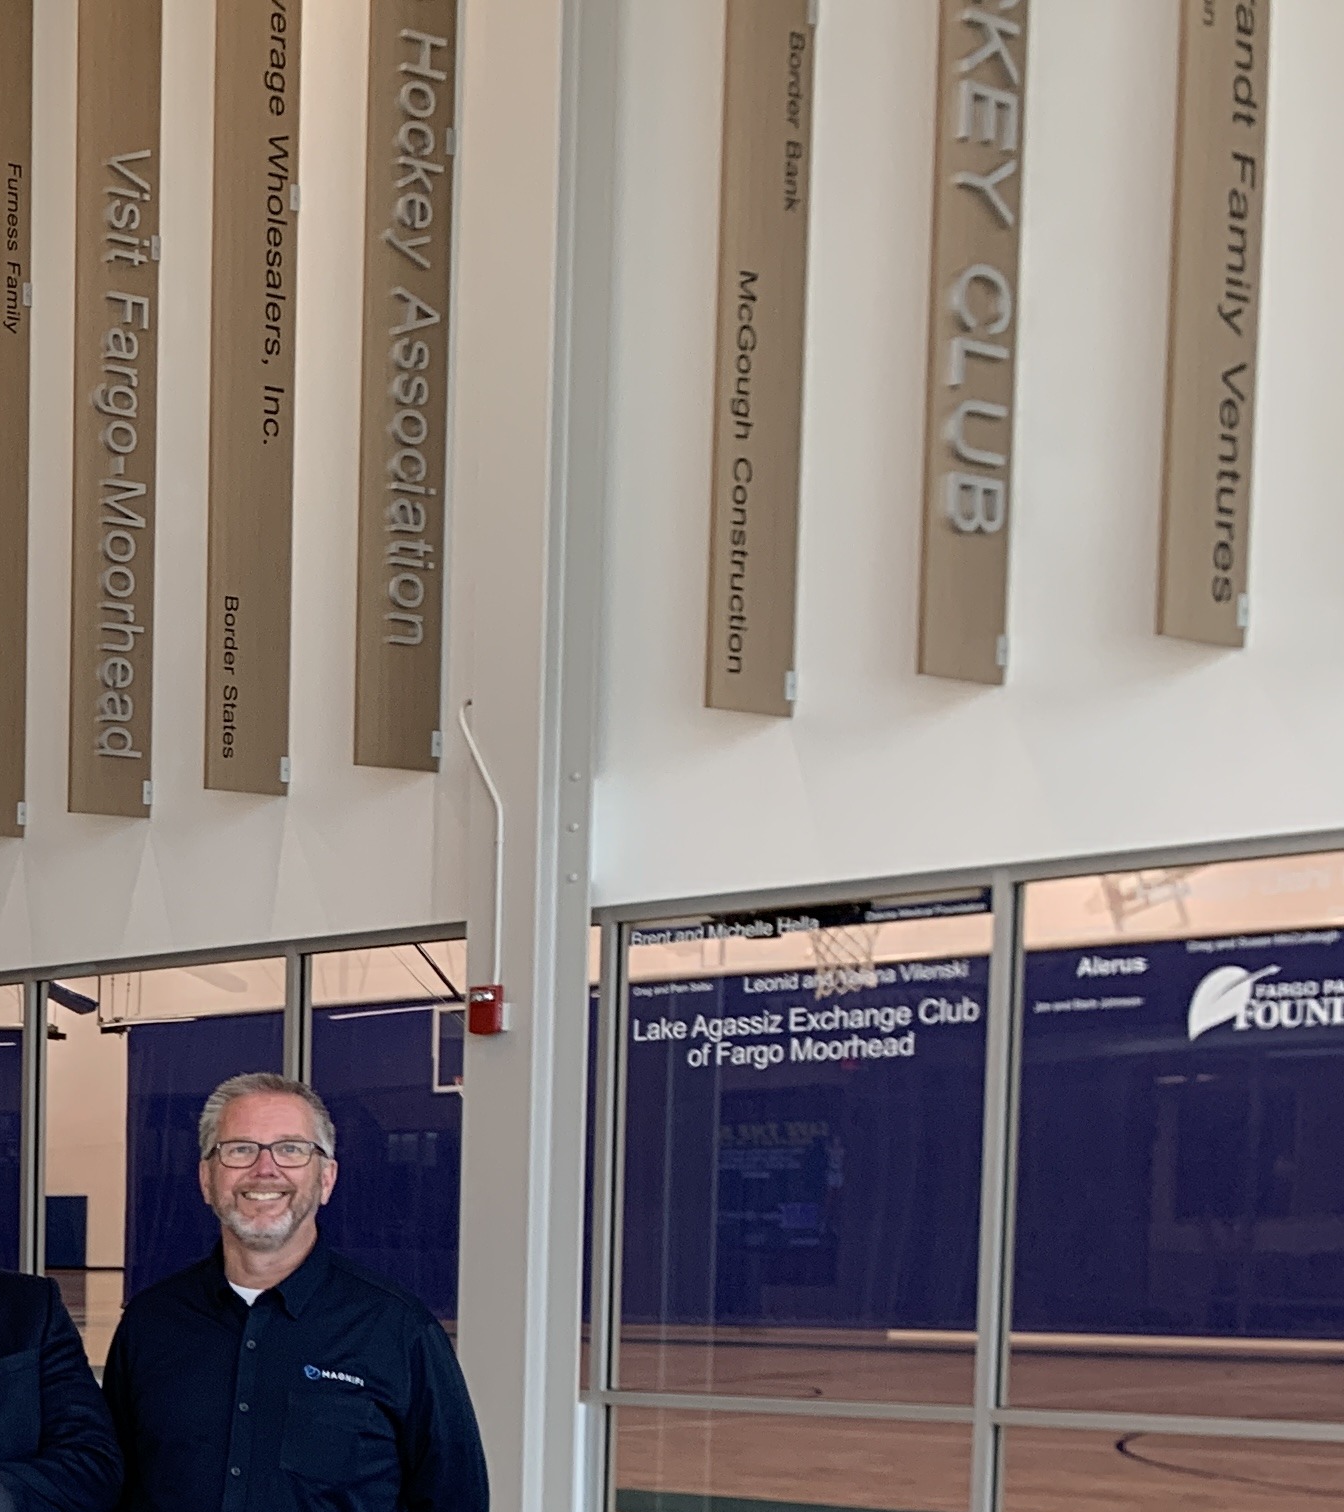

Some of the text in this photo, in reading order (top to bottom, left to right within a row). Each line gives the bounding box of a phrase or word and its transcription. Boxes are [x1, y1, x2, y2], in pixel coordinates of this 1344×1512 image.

[782, 31, 807, 213] Border Bank
[3, 162, 23, 333] Furness Family
[262, 133, 289, 364] Wholesalers,
[944, 0, 1021, 539] KEY CLUB
[1210, 0, 1258, 604] andt Family Ventures
[262, 386, 282, 445] Inc.
[382, 28, 449, 648] Hockey Association
[92, 149, 152, 760] Visit Fargo-Moorhead
[725, 271, 760, 676] McGough Construction
[220, 595, 240, 760] Border States
[630, 930, 672, 946] Brent
[676, 927, 704, 943] and
[708, 919, 774, 938] Michelle
[743, 974, 800, 993] Leonid
[1077, 956, 1149, 978] Alerus
[633, 997, 980, 1043] Lake Agassiz Exchange Club
[687, 1032, 915, 1070] of Fargo Moorhead
